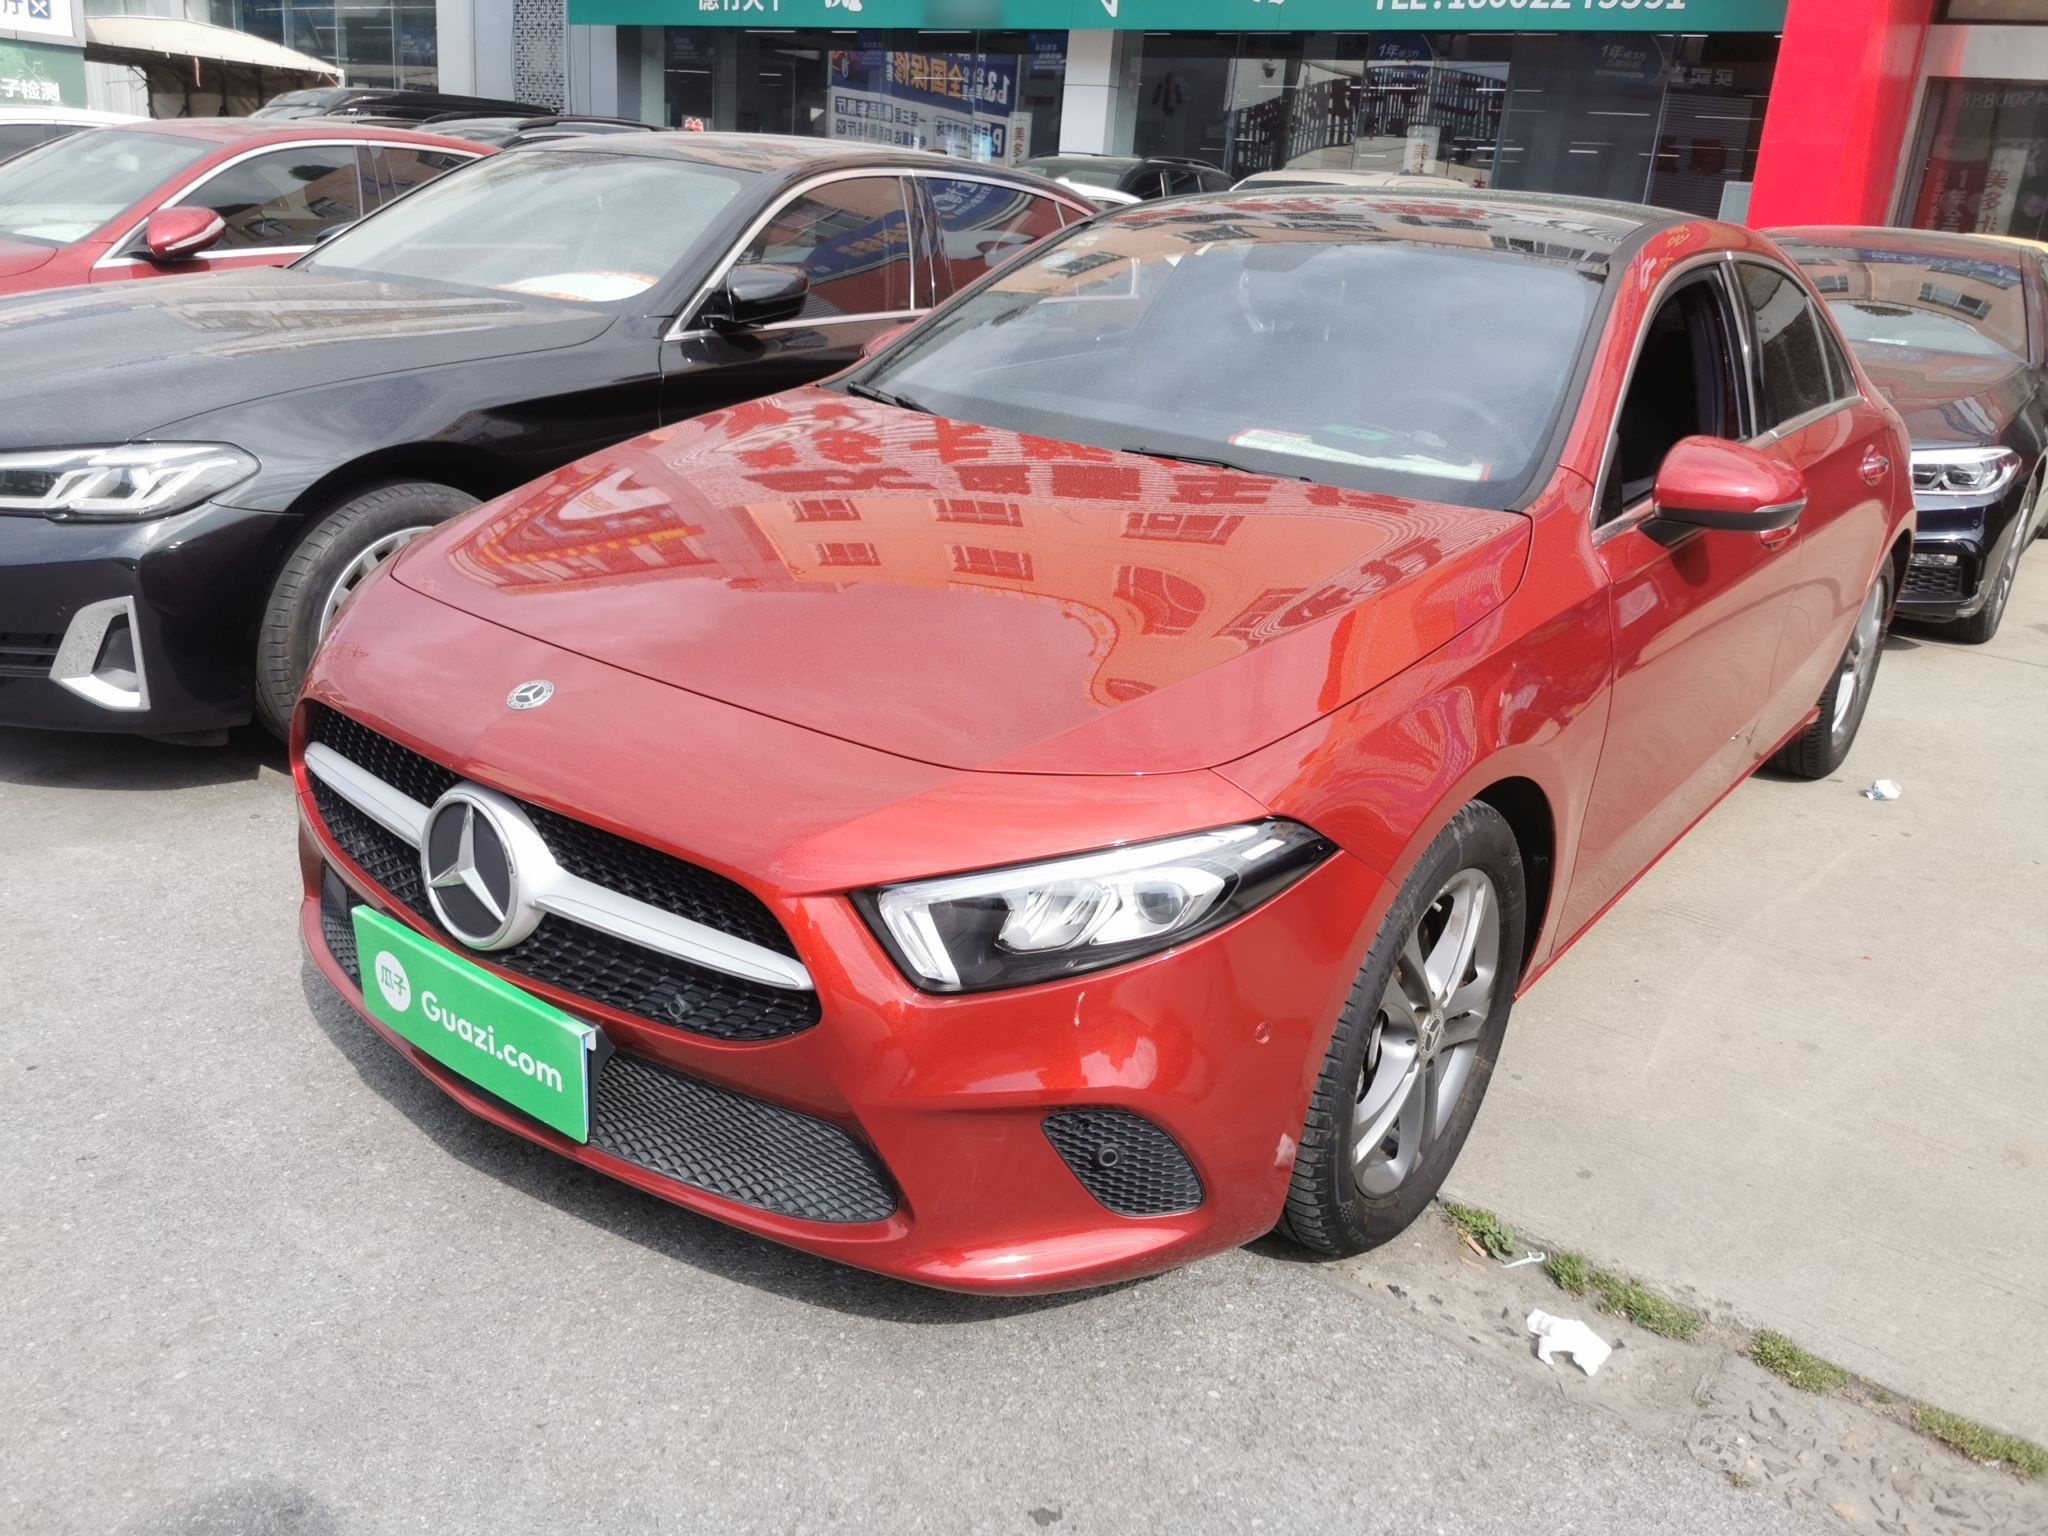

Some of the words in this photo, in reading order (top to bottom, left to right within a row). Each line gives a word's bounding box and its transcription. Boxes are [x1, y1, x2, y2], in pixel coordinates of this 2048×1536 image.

[0, 78, 61, 102] 子检测
[380, 965, 407, 997] 瓜子
[420, 990, 564, 1093] Guazi.com
